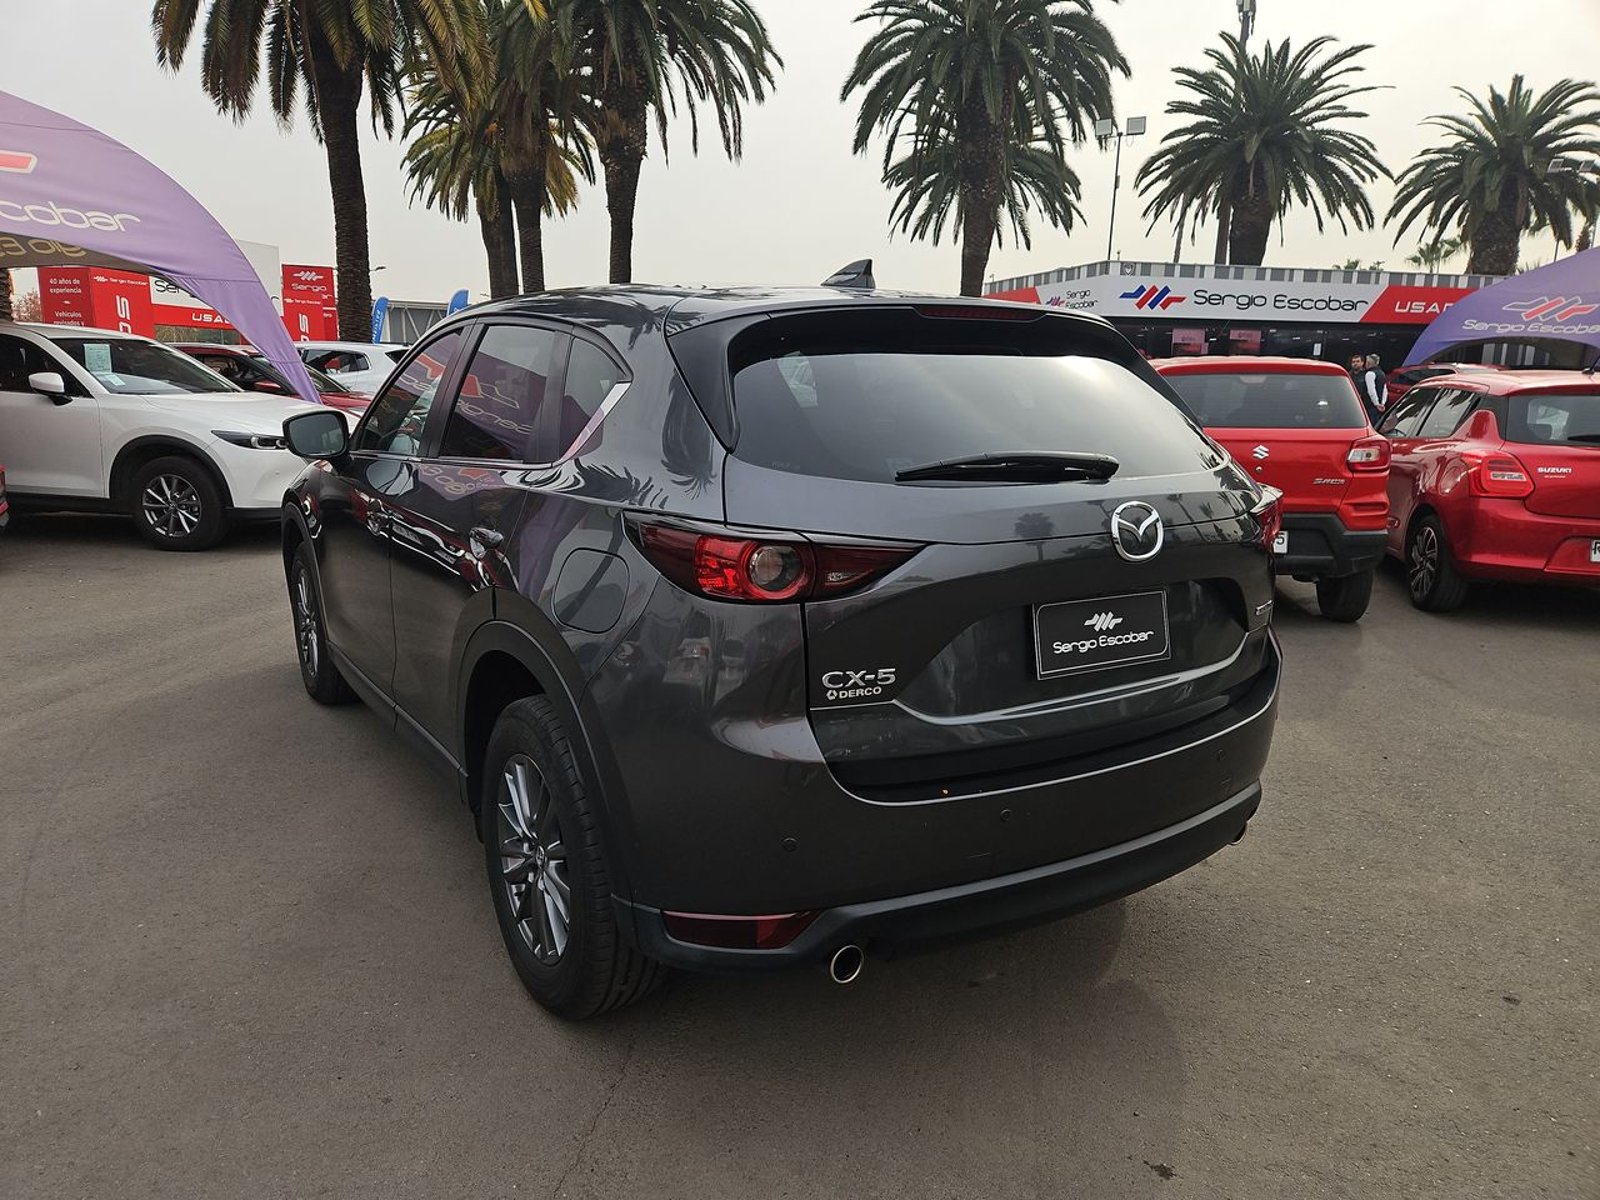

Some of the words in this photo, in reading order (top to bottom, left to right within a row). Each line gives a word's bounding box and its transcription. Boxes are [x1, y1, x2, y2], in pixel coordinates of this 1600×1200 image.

[1193, 289, 1267, 310] Sergio
[1273, 294, 1368, 312] Escobar
[1462, 319, 1525, 333] Sergio
[1053, 638, 1098, 655] Sergio
[1099, 630, 1154, 647] Escobar
[822, 668, 896, 689] CX-5
[839, 686, 882, 699] DERCO
